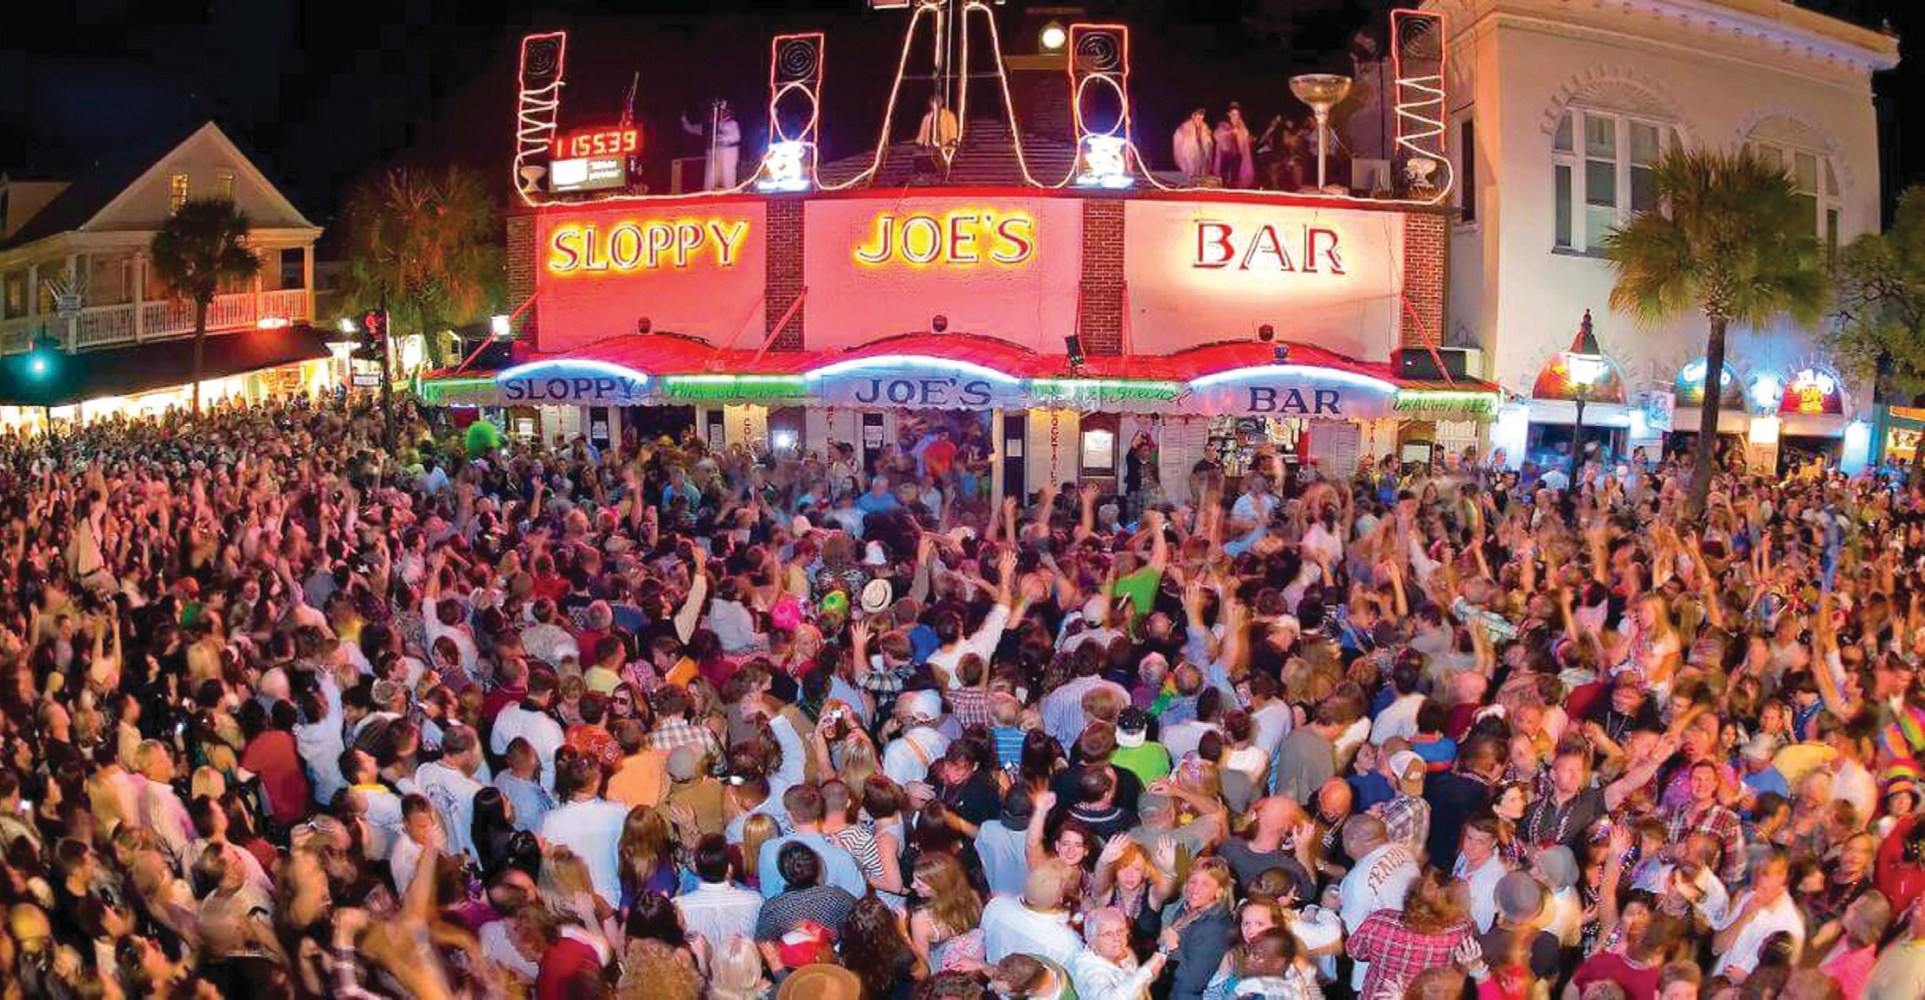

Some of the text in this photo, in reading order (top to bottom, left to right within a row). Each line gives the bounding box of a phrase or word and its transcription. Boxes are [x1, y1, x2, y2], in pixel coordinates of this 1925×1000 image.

[551, 214, 1346, 275] SLOPPY JOE'S BAR
[505, 378, 635, 399] SLOPPY
[855, 377, 992, 405] JOE'S
[1247, 387, 1341, 414] BAR
